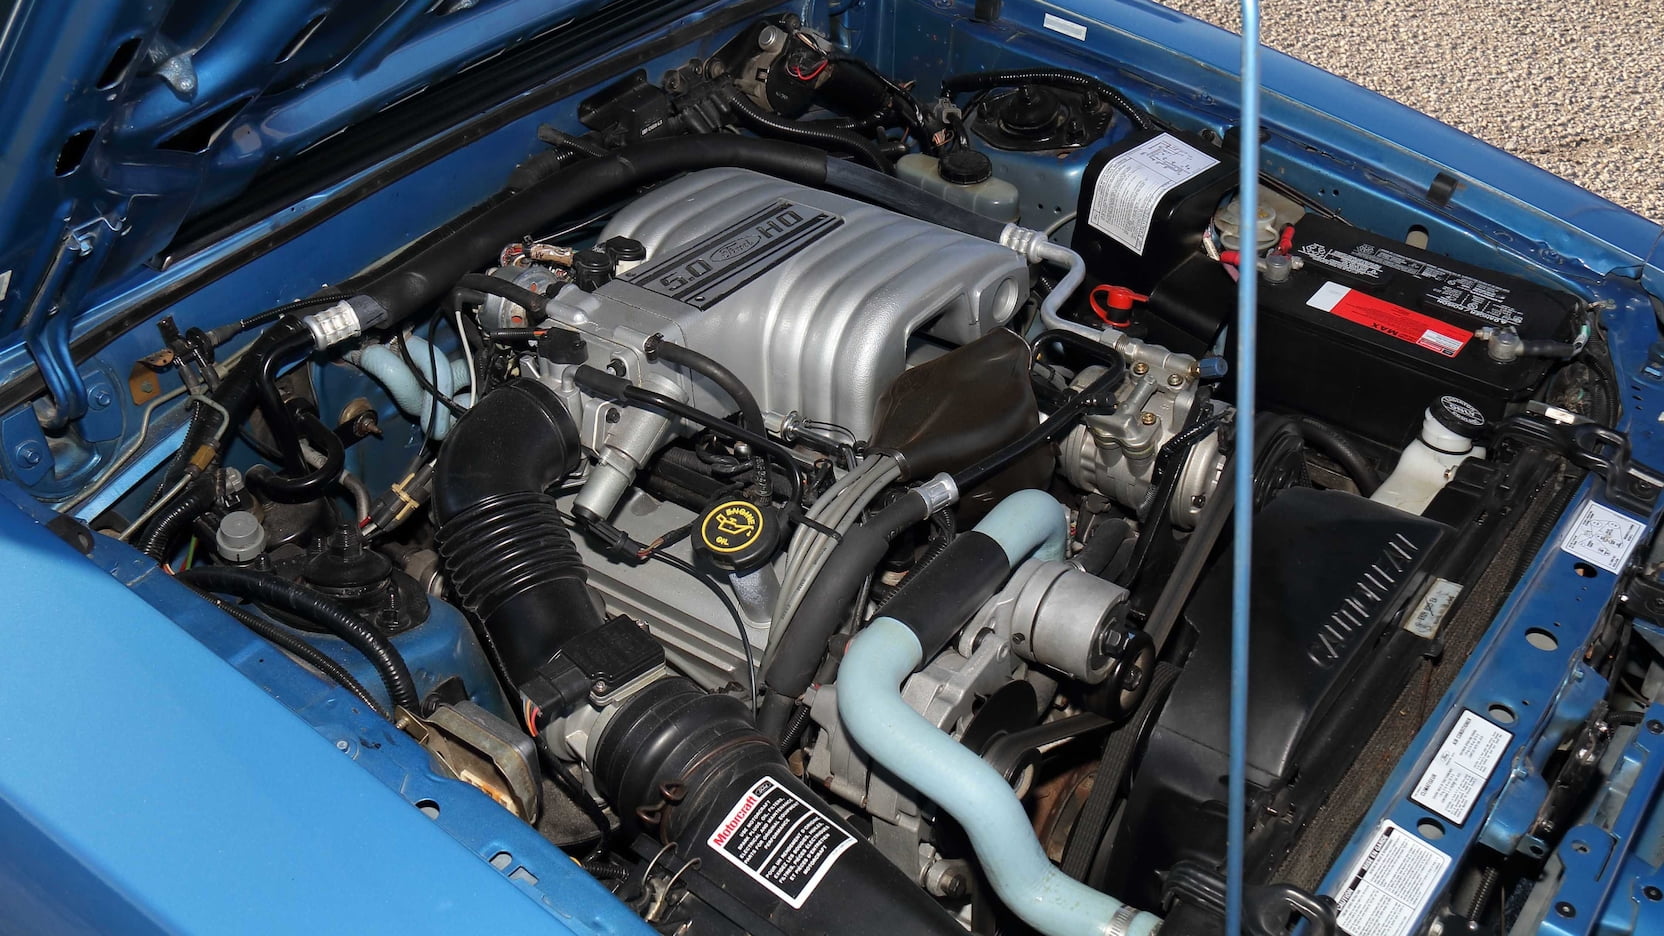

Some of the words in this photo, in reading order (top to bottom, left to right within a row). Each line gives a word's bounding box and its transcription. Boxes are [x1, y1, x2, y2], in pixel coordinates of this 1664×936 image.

[659, 258, 712, 291] 5.0
[756, 210, 804, 239] HO
[1372, 322, 1400, 340] MAX
[726, 508, 756, 525] ENGINE
[716, 536, 729, 546] OIL
[713, 796, 758, 846] Motorcraft
[747, 800, 771, 828] MOTORCRAFT
[737, 836, 750, 850] SPARK
[739, 834, 761, 859] ELECTRICAL
[760, 823, 768, 833] AND
[744, 849, 757, 864] PARTS
[755, 840, 764, 850] FOR
[763, 820, 780, 840] ORIGINAL
[764, 818, 790, 849] PERFORMANCE
[765, 865, 777, 878] POUR
[781, 832, 802, 859] RENDEMENT
[786, 854, 794, 863] LES
[803, 845, 827, 875] MOTORCRAFT
[1337, 888, 1354, 910] CAUTION
